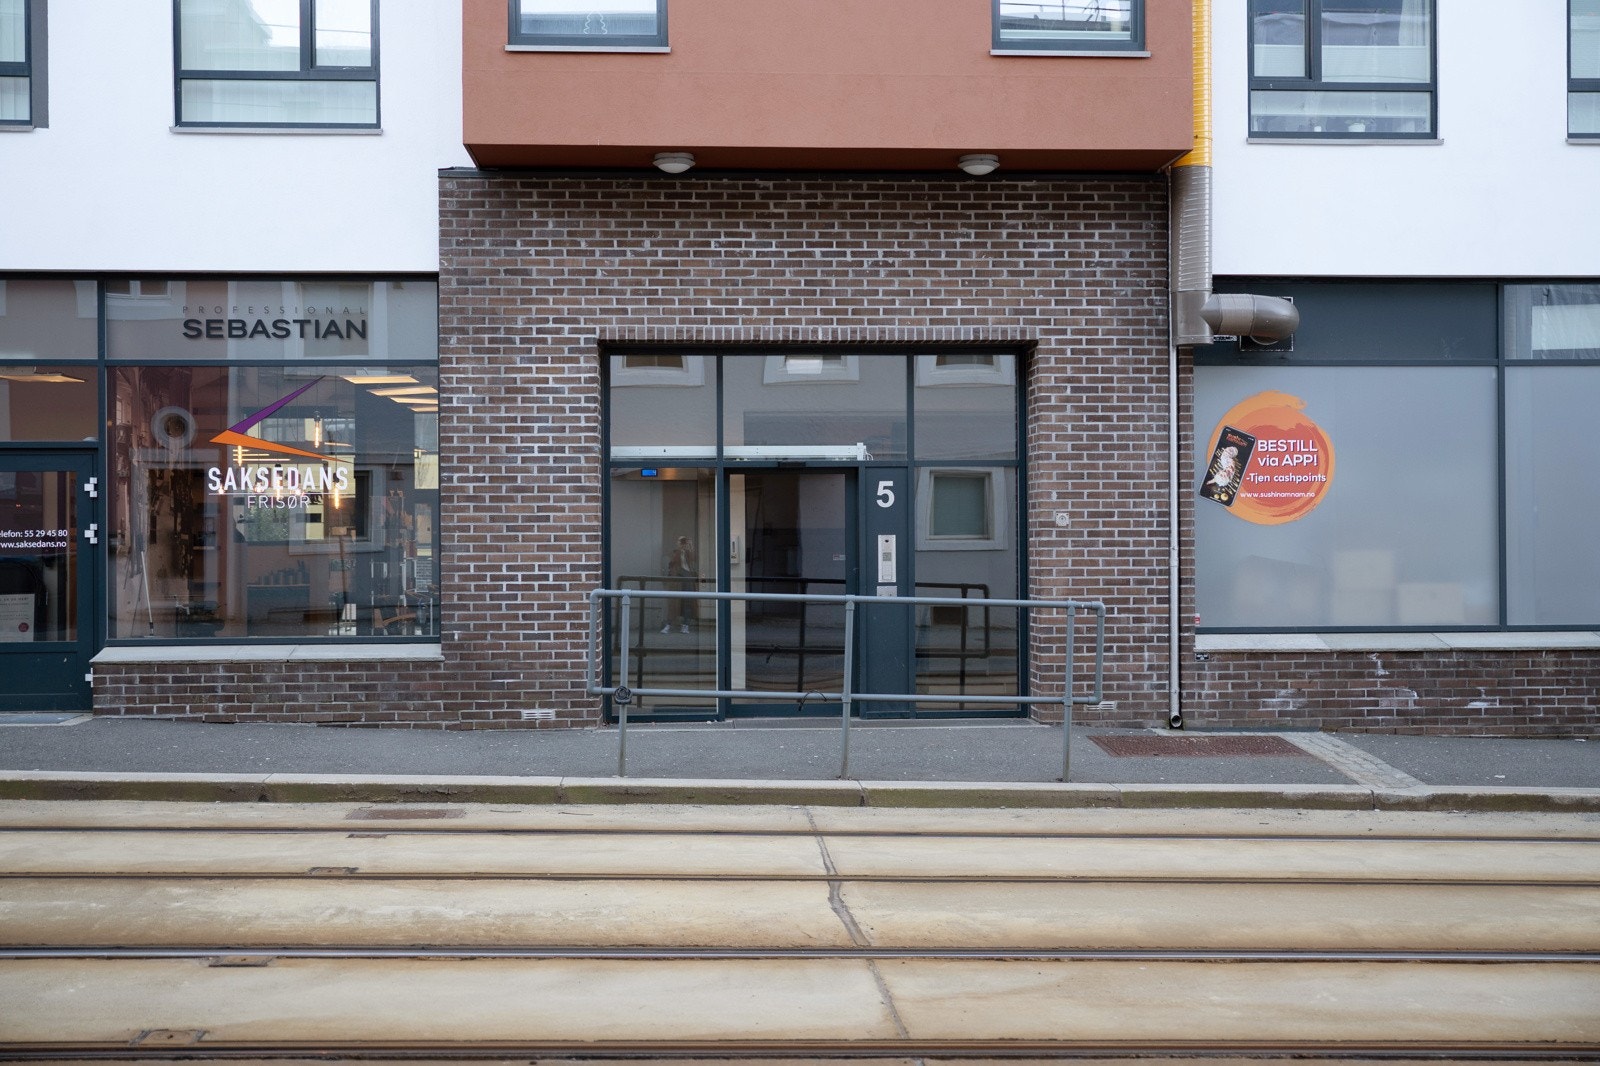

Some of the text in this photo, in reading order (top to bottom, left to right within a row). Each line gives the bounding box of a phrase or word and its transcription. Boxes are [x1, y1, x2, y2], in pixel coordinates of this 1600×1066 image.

[182, 306, 365, 315] PROFESSIONAL
[182, 318, 367, 340] SEBASTIAN
[1257, 439, 1318, 452] BESTILL
[1257, 454, 1317, 467] via APP!
[208, 466, 348, 491] SAKSEDANS
[1273, 472, 1327, 484] cashpoints
[876, 480, 895, 508] 5
[247, 495, 310, 509] FRISØR
[24, 530, 34, 538] 55
[35, 530, 46, 538] 29
[57, 529, 68, 537] 80
[0, 540, 67, 548] ww.saksedans.no
